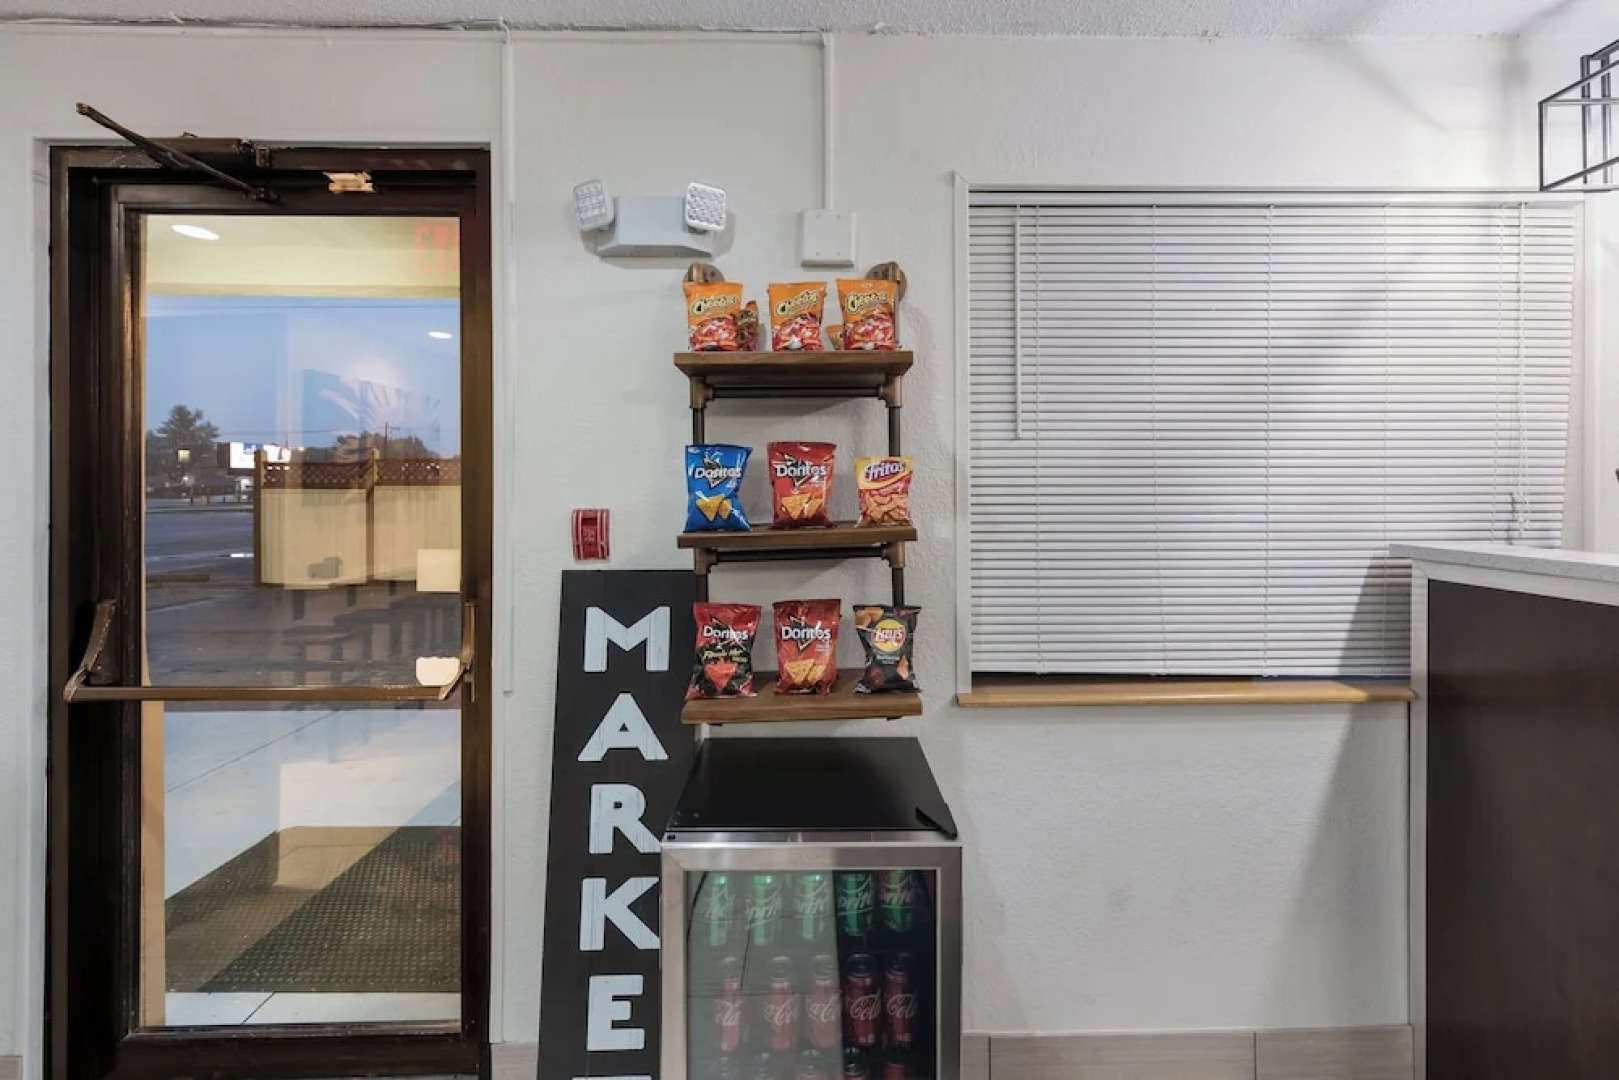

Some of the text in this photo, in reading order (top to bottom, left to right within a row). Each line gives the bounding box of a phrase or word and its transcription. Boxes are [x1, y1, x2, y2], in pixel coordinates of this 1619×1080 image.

[694, 466, 742, 480] Doritos
[773, 463, 826, 478] Doritos
[703, 624, 748, 640] Doritos
[781, 625, 831, 640] Doritos
[573, 606, 671, 1080] MARKE
